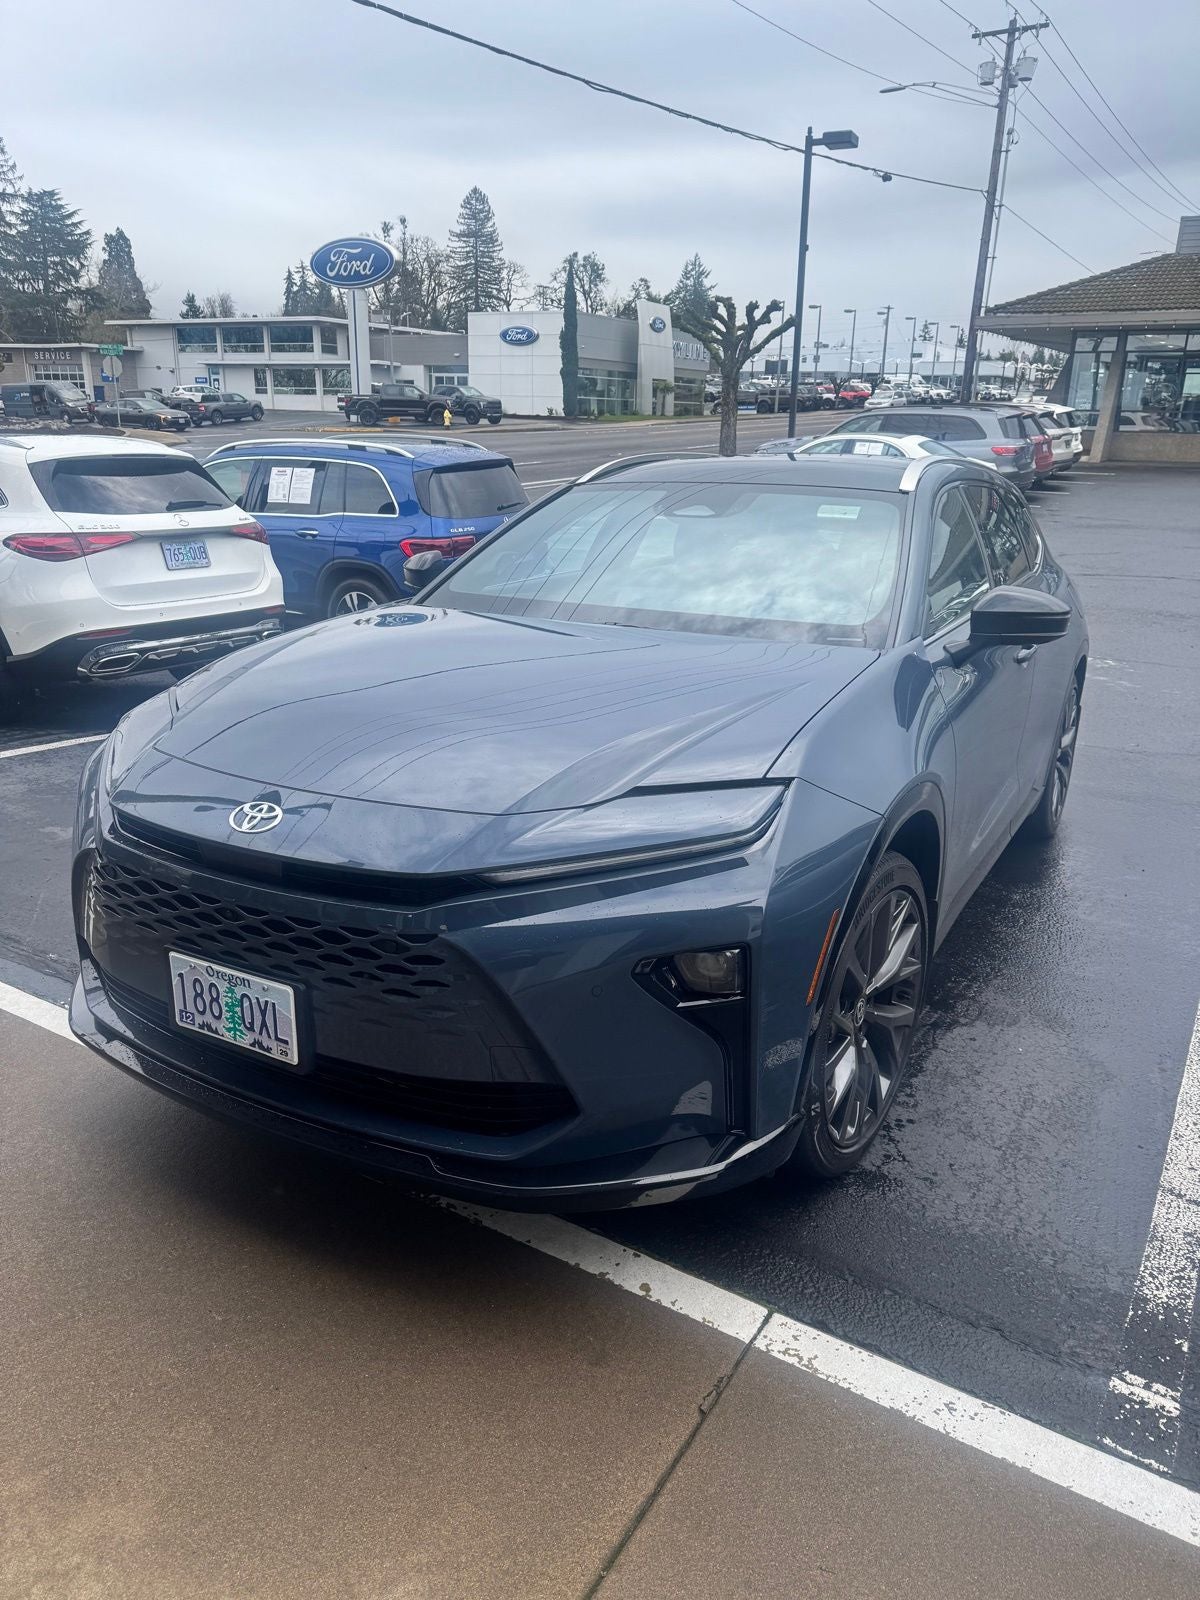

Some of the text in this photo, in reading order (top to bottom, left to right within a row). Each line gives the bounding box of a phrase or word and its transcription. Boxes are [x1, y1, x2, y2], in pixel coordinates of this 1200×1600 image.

[326, 247, 375, 277] Ford
[506, 328, 528, 341] Ford
[34, 351, 71, 360] SERVICE
[673, 341, 709, 362] KYLINE
[165, 547, 185, 563] 765
[205, 965, 252, 989] Oregon
[177, 972, 289, 1046] 188 QXL
[181, 1011, 193, 1023] 12
[279, 1048, 289, 1058] 29
